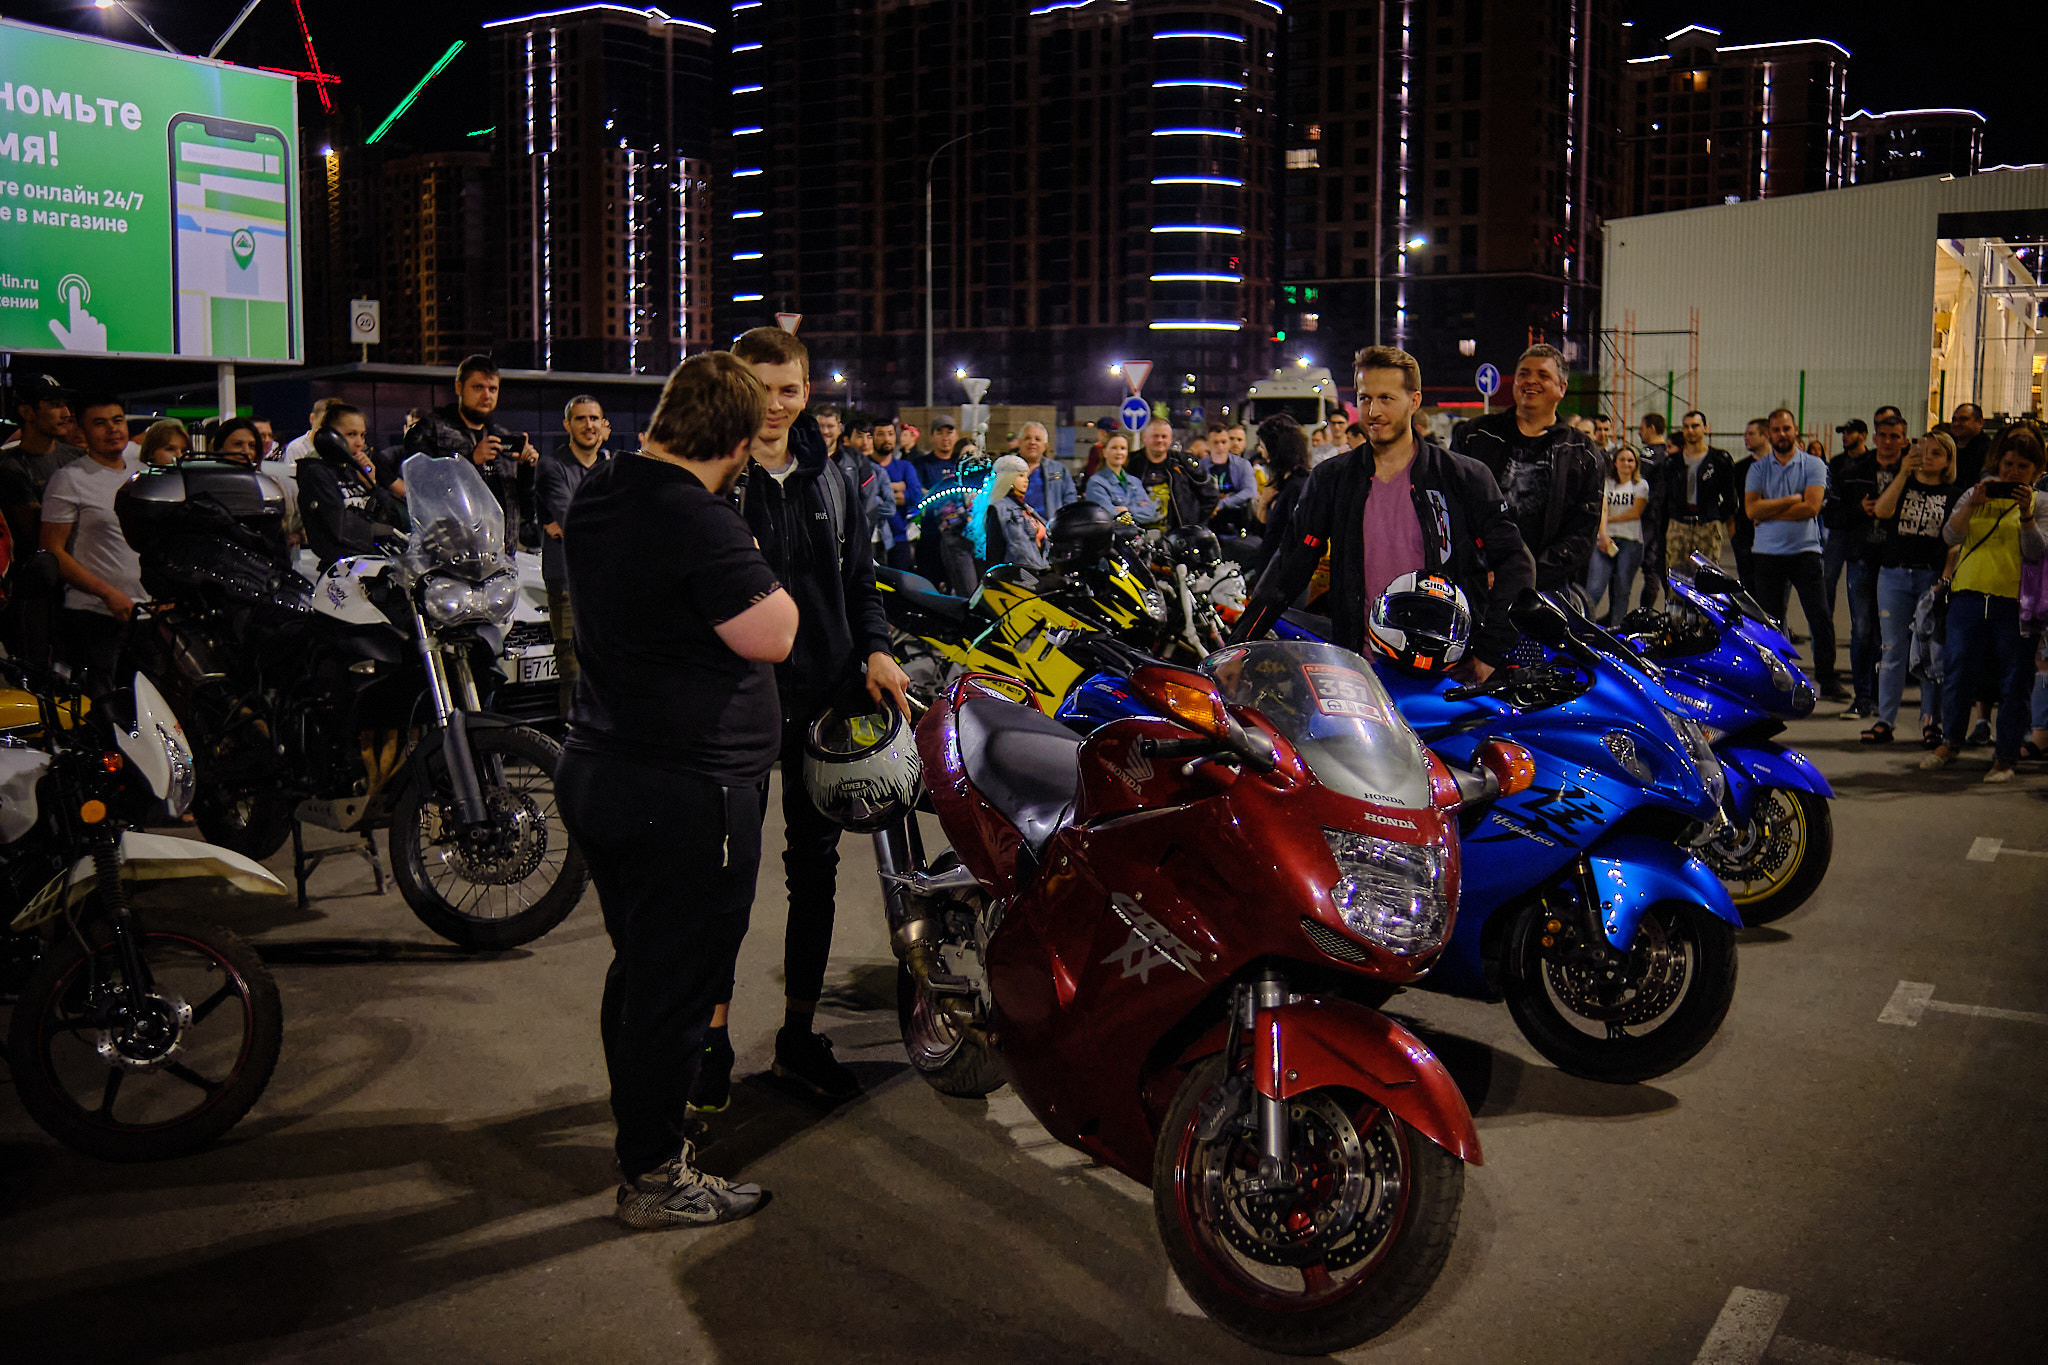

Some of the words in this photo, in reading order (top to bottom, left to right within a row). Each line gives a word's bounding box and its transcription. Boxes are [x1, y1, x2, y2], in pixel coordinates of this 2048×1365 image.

[23, 183, 99, 206] онлайн
[103, 189, 144, 211] 24/7
[16, 207, 28, 222] в
[32, 209, 128, 233] магазине
[0, 295, 39, 310] ении
[1318, 679, 1368, 702] 351
[1105, 761, 1142, 796] HONDA
[1363, 792, 1406, 806] HONDA
[1363, 812, 1418, 831] HONDA
[1492, 813, 1556, 847] Hayabusa
[1111, 904, 1133, 926] 1100
